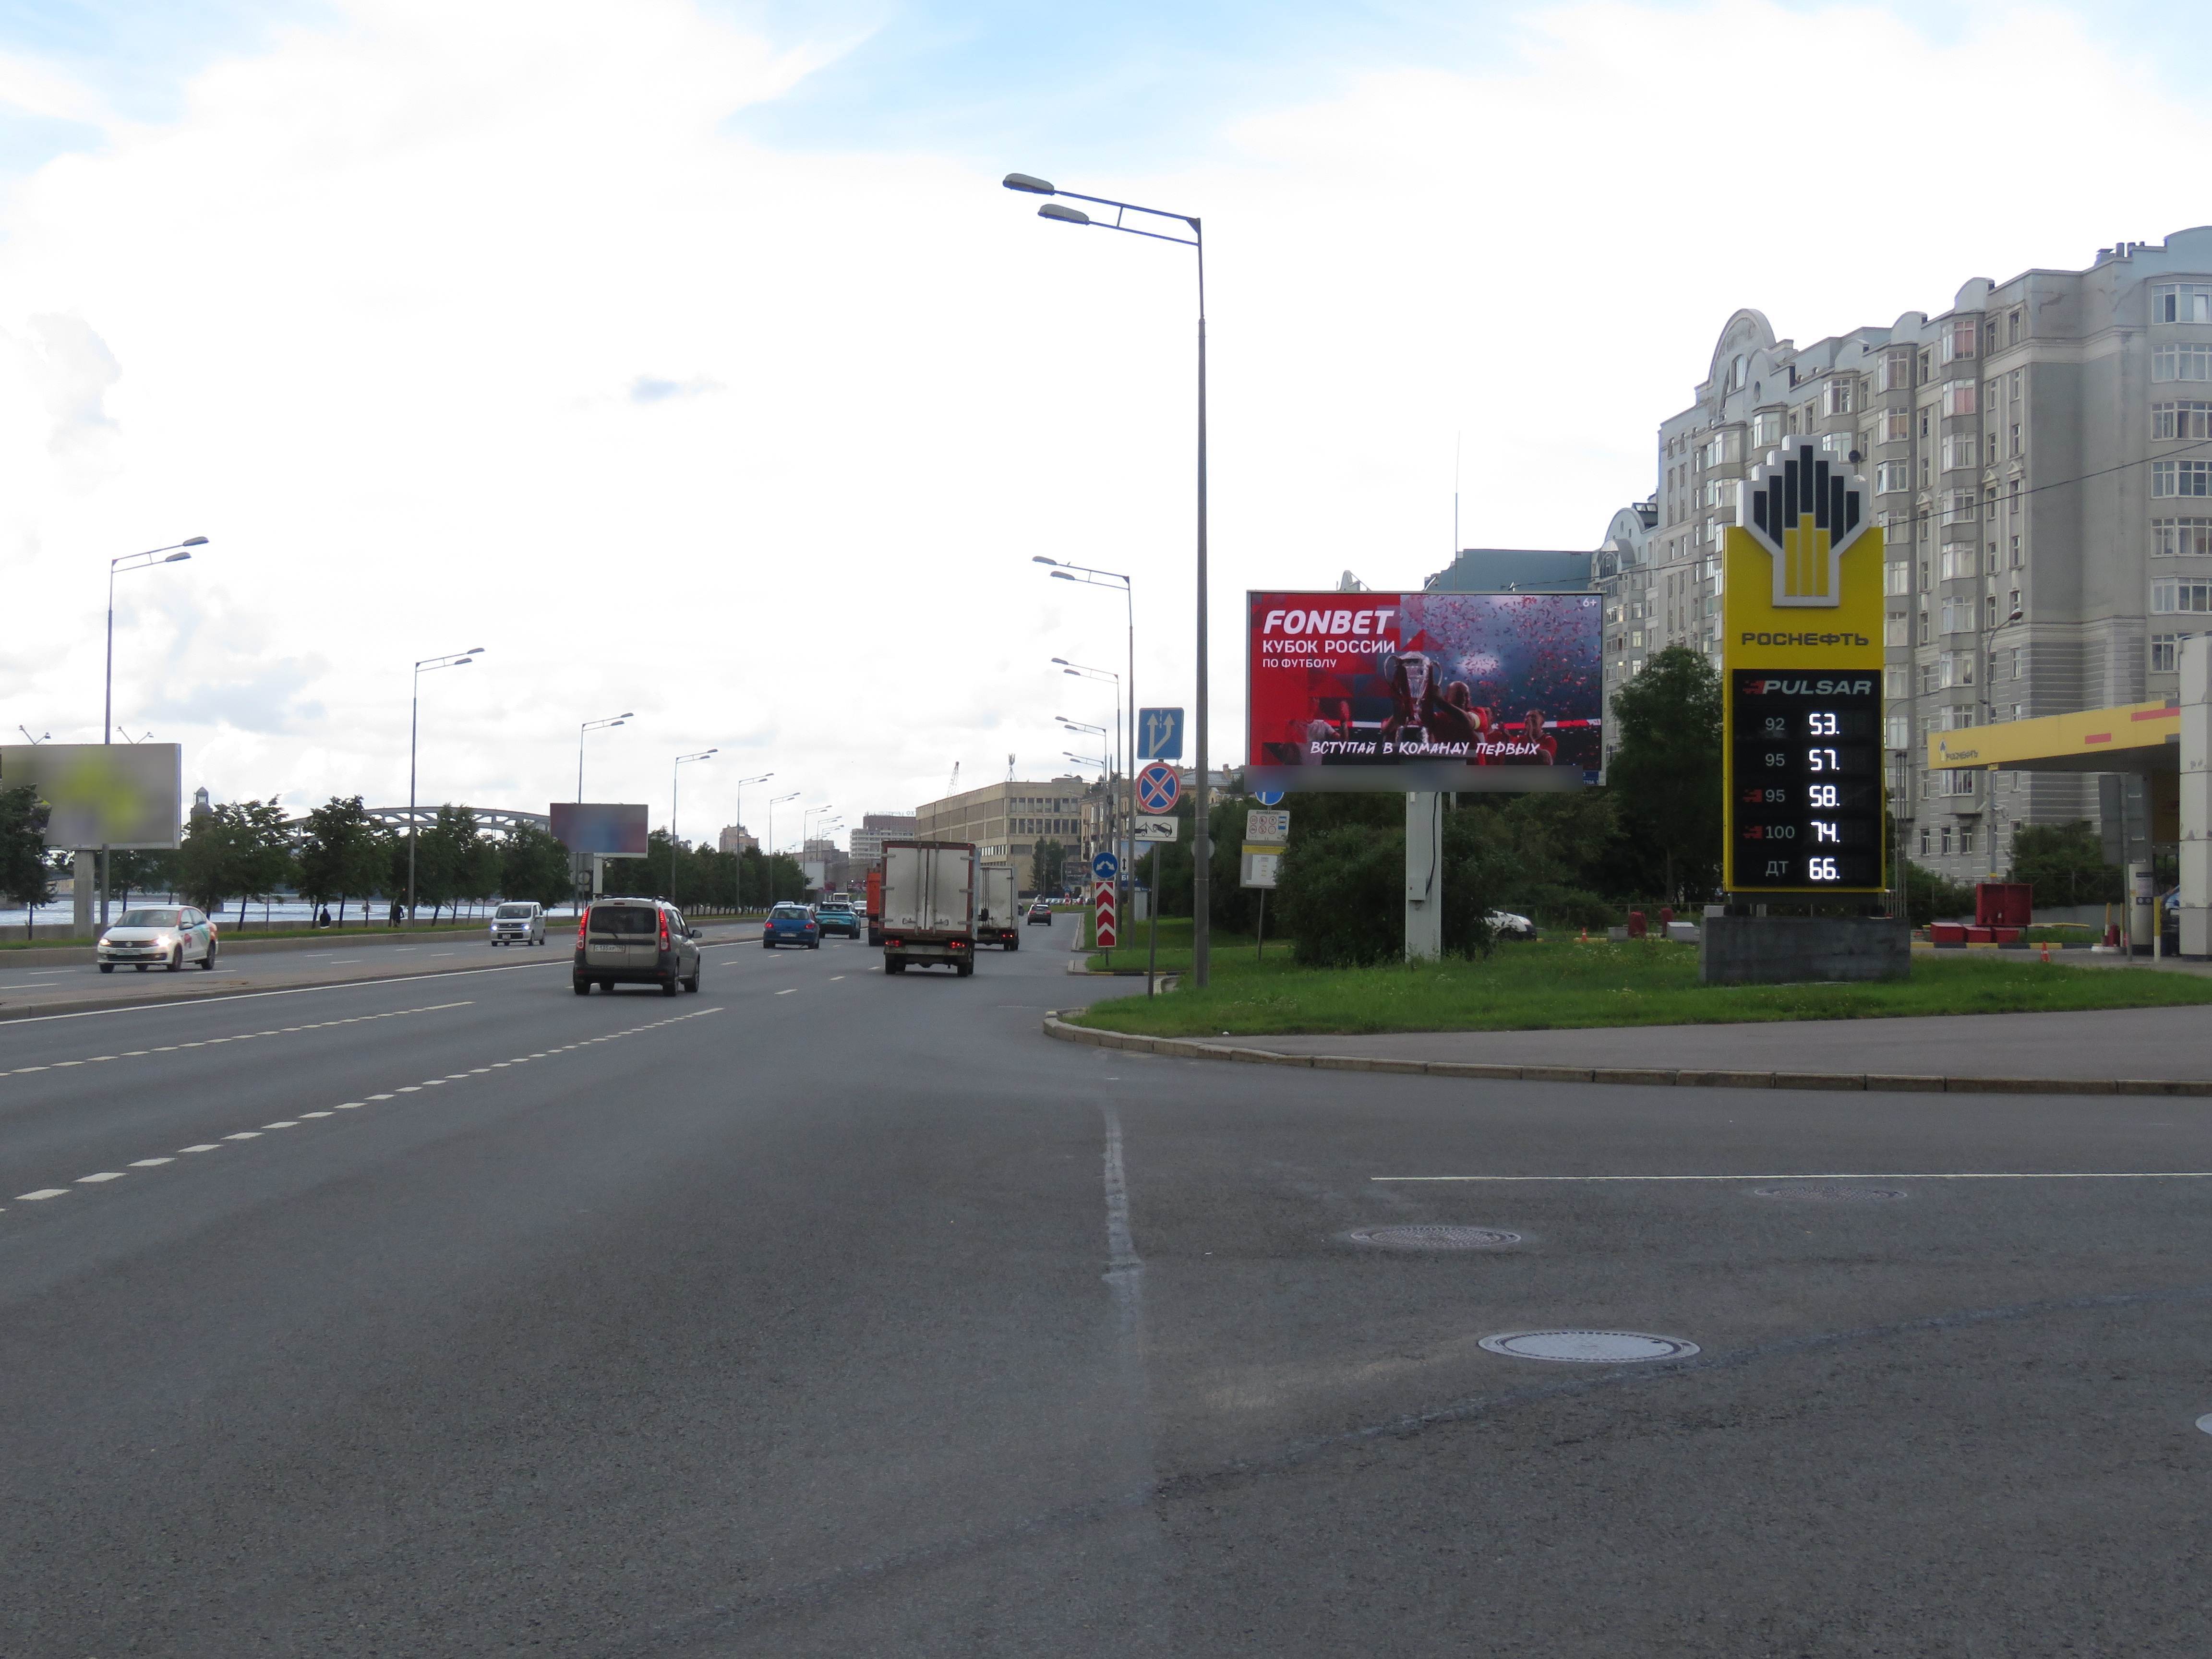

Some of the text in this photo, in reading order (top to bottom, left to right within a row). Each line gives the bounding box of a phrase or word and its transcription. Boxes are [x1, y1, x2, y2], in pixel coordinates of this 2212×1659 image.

[1583, 598, 1597, 607] 6+
[1263, 610, 1395, 634] FONBET
[1741, 632, 1869, 646] РОСНЕФТЬ
[1262, 640, 1395, 653] КУБОК РОССИИ
[1262, 659, 1337, 668] ПО ФУТБОЛУ
[1762, 680, 1872, 695] PULSAR
[1765, 718, 1785, 731] 92
[1310, 741, 1540, 757] ВСТУПАЙ В КОМАНДУ ПЕРВЫХ
[1765, 754, 1785, 767] 95
[1765, 790, 1785, 802] 95
[1765, 826, 1795, 839] 100
[1766, 861, 1789, 877] ДТ
